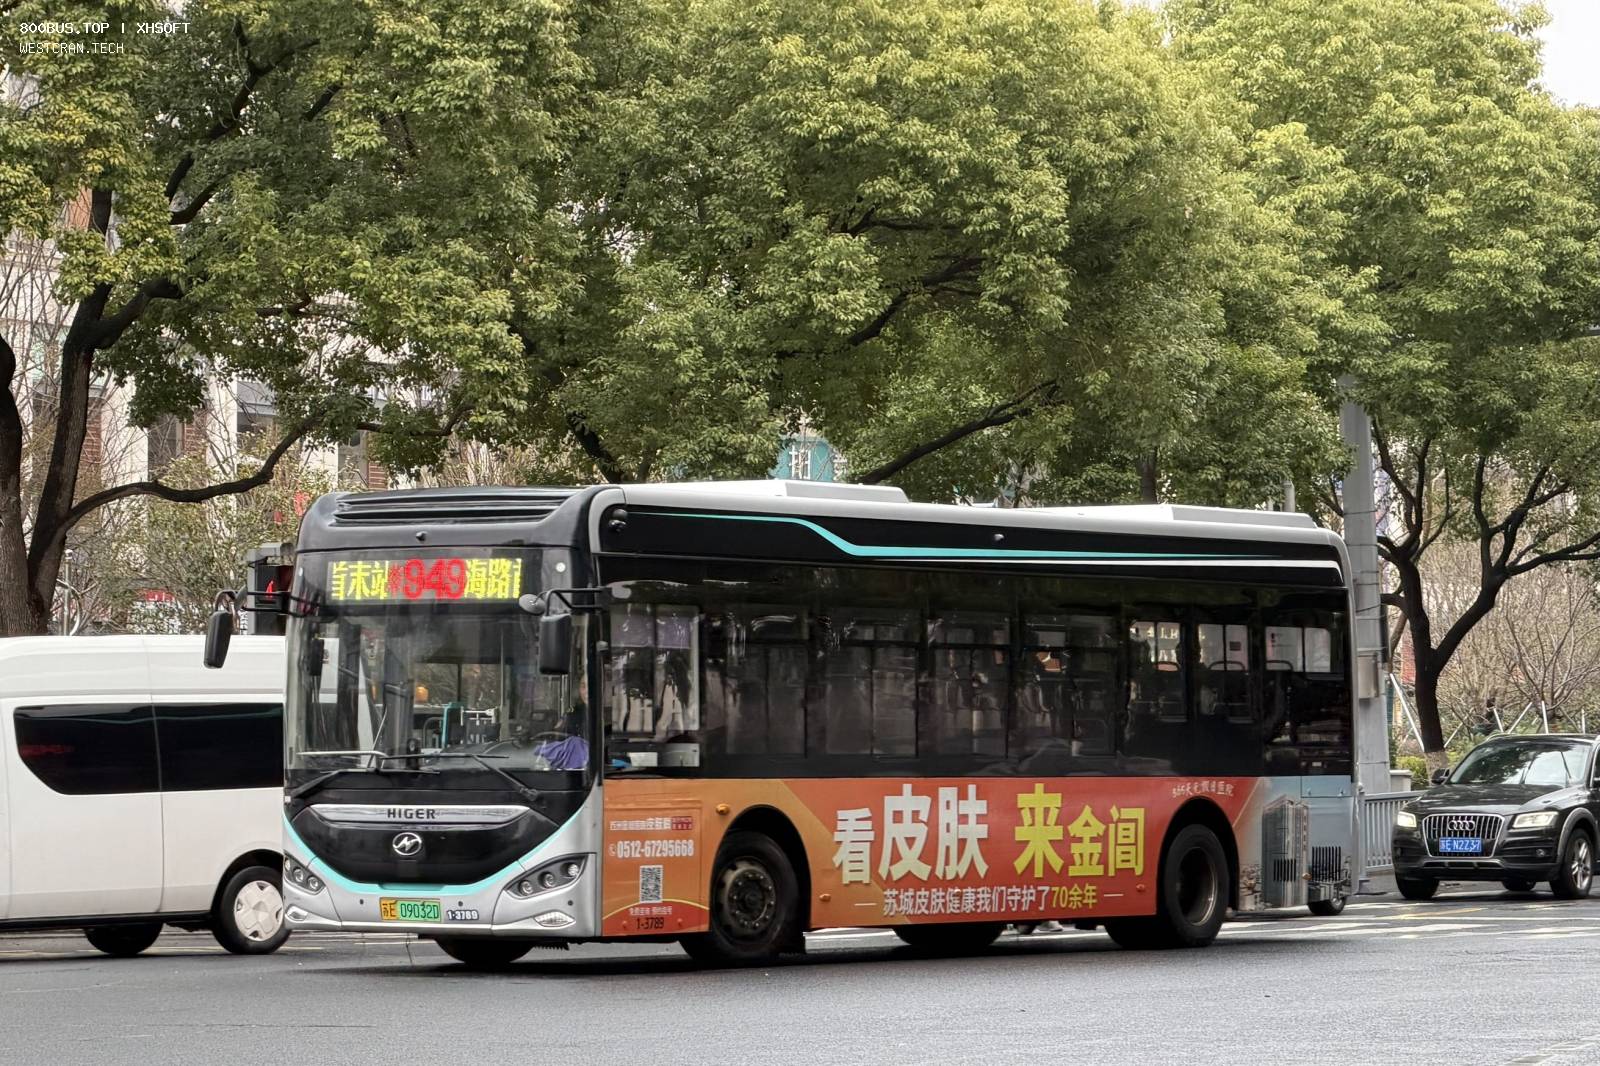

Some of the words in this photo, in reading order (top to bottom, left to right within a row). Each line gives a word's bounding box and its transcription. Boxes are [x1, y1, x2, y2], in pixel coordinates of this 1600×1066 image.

[405, 558, 468, 601] 949
[387, 807, 436, 819] HIGER
[617, 839, 695, 859] 0512-67295668
[832, 783, 989, 885] 看皮肤
[1013, 783, 1145, 878] 来金阊
[883, 883, 1098, 916] 苏城皮肤健康我们守护了70余年
